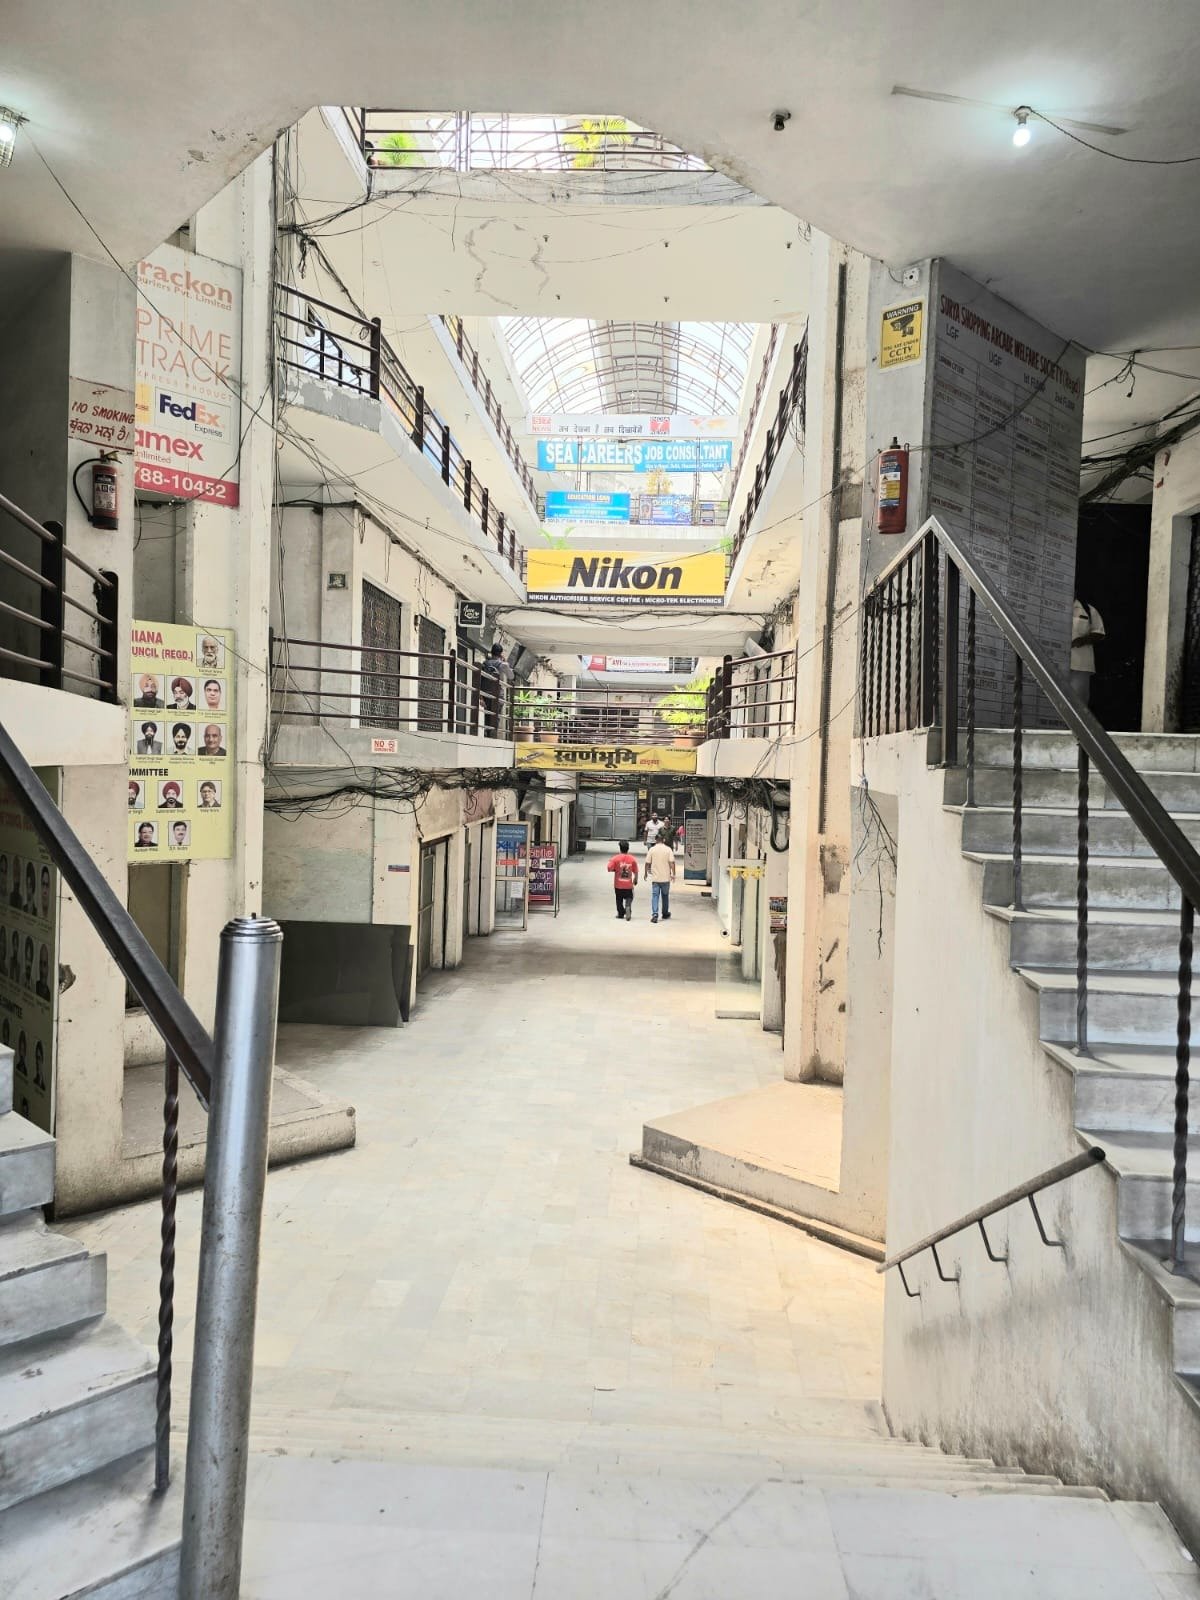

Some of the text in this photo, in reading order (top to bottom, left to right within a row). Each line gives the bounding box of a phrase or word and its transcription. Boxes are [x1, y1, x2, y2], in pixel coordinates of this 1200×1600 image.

[195, 291, 232, 312] Limited
[886, 303, 919, 319] WARNING
[136, 308, 232, 361] PRIME
[940, 294, 960, 324] SURYA
[961, 306, 991, 342] SHOPPING
[991, 325, 1014, 356] ARCADE
[1014, 339, 1040, 371] WELFARE
[1040, 355, 1065, 383] SOCIETY
[946, 323, 960, 342] LGF
[889, 346, 913, 358] CCTV
[988, 351, 1002, 369] UGF
[136, 338, 230, 387] TRACK
[71, 401, 88, 414] NO
[92, 405, 135, 425] SMOKING
[159, 394, 221, 428] FedEx
[194, 423, 223, 438] Express
[545, 443, 729, 465] SEA CAREERS JOB CONSULTANT
[567, 556, 683, 590] Nikon
[131, 646, 194, 662] UNCIL (REGD.)
[374, 740, 385, 748] NO
[129, 768, 169, 777] MMITTEE
